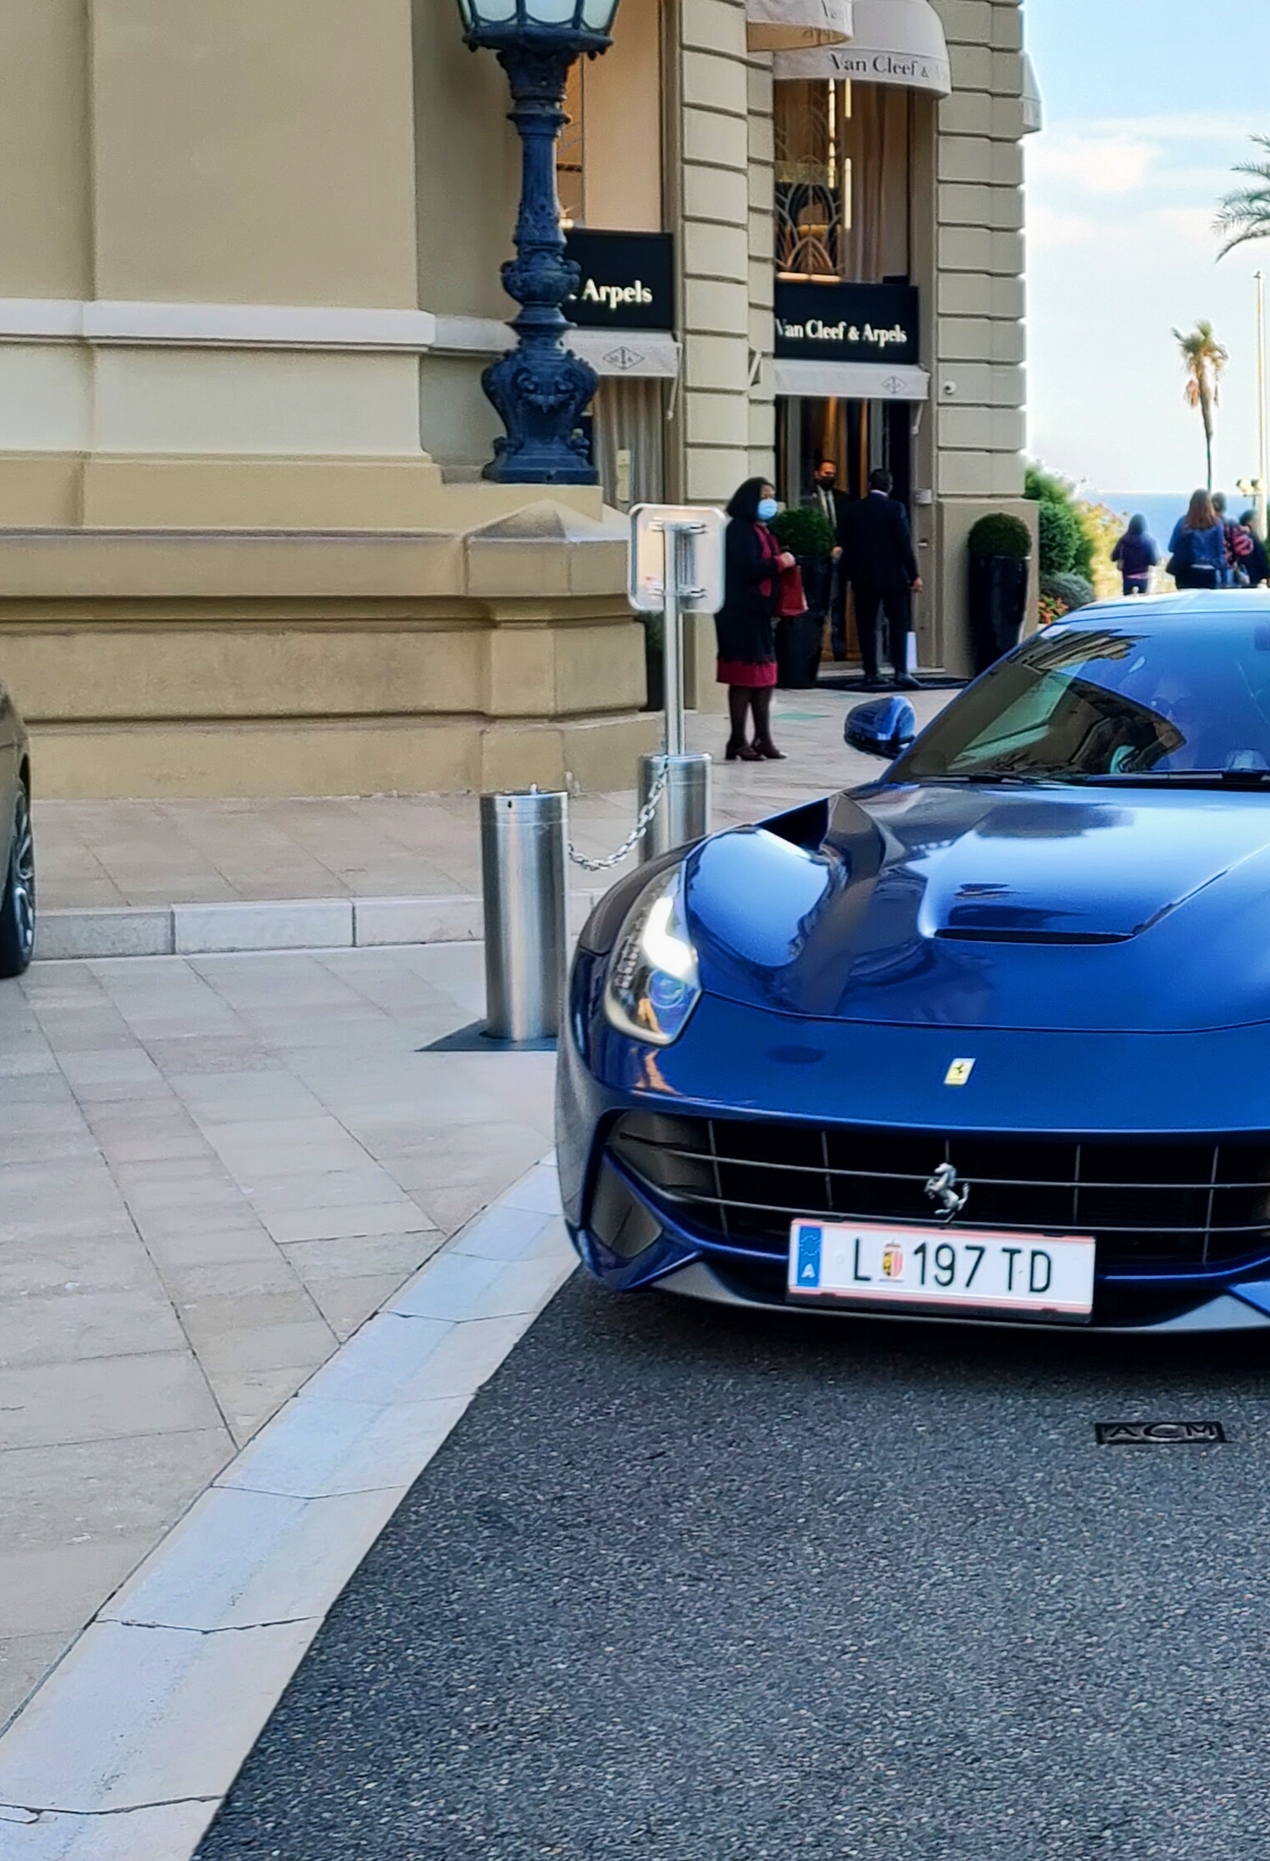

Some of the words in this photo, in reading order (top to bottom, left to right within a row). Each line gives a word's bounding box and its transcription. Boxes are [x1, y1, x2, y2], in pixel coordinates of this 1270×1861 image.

[830, 53, 867, 73] Van
[872, 55, 919, 77] Cleef
[920, 66, 930, 78] &
[583, 278, 653, 309] Arpels
[775, 318, 804, 338] Van
[805, 319, 847, 340] Cleef
[848, 325, 860, 341] &
[862, 323, 908, 348] Arpels
[801, 1263, 816, 1279] A
[853, 1238, 872, 1282] L
[1106, 1422, 1217, 1440] ACM
